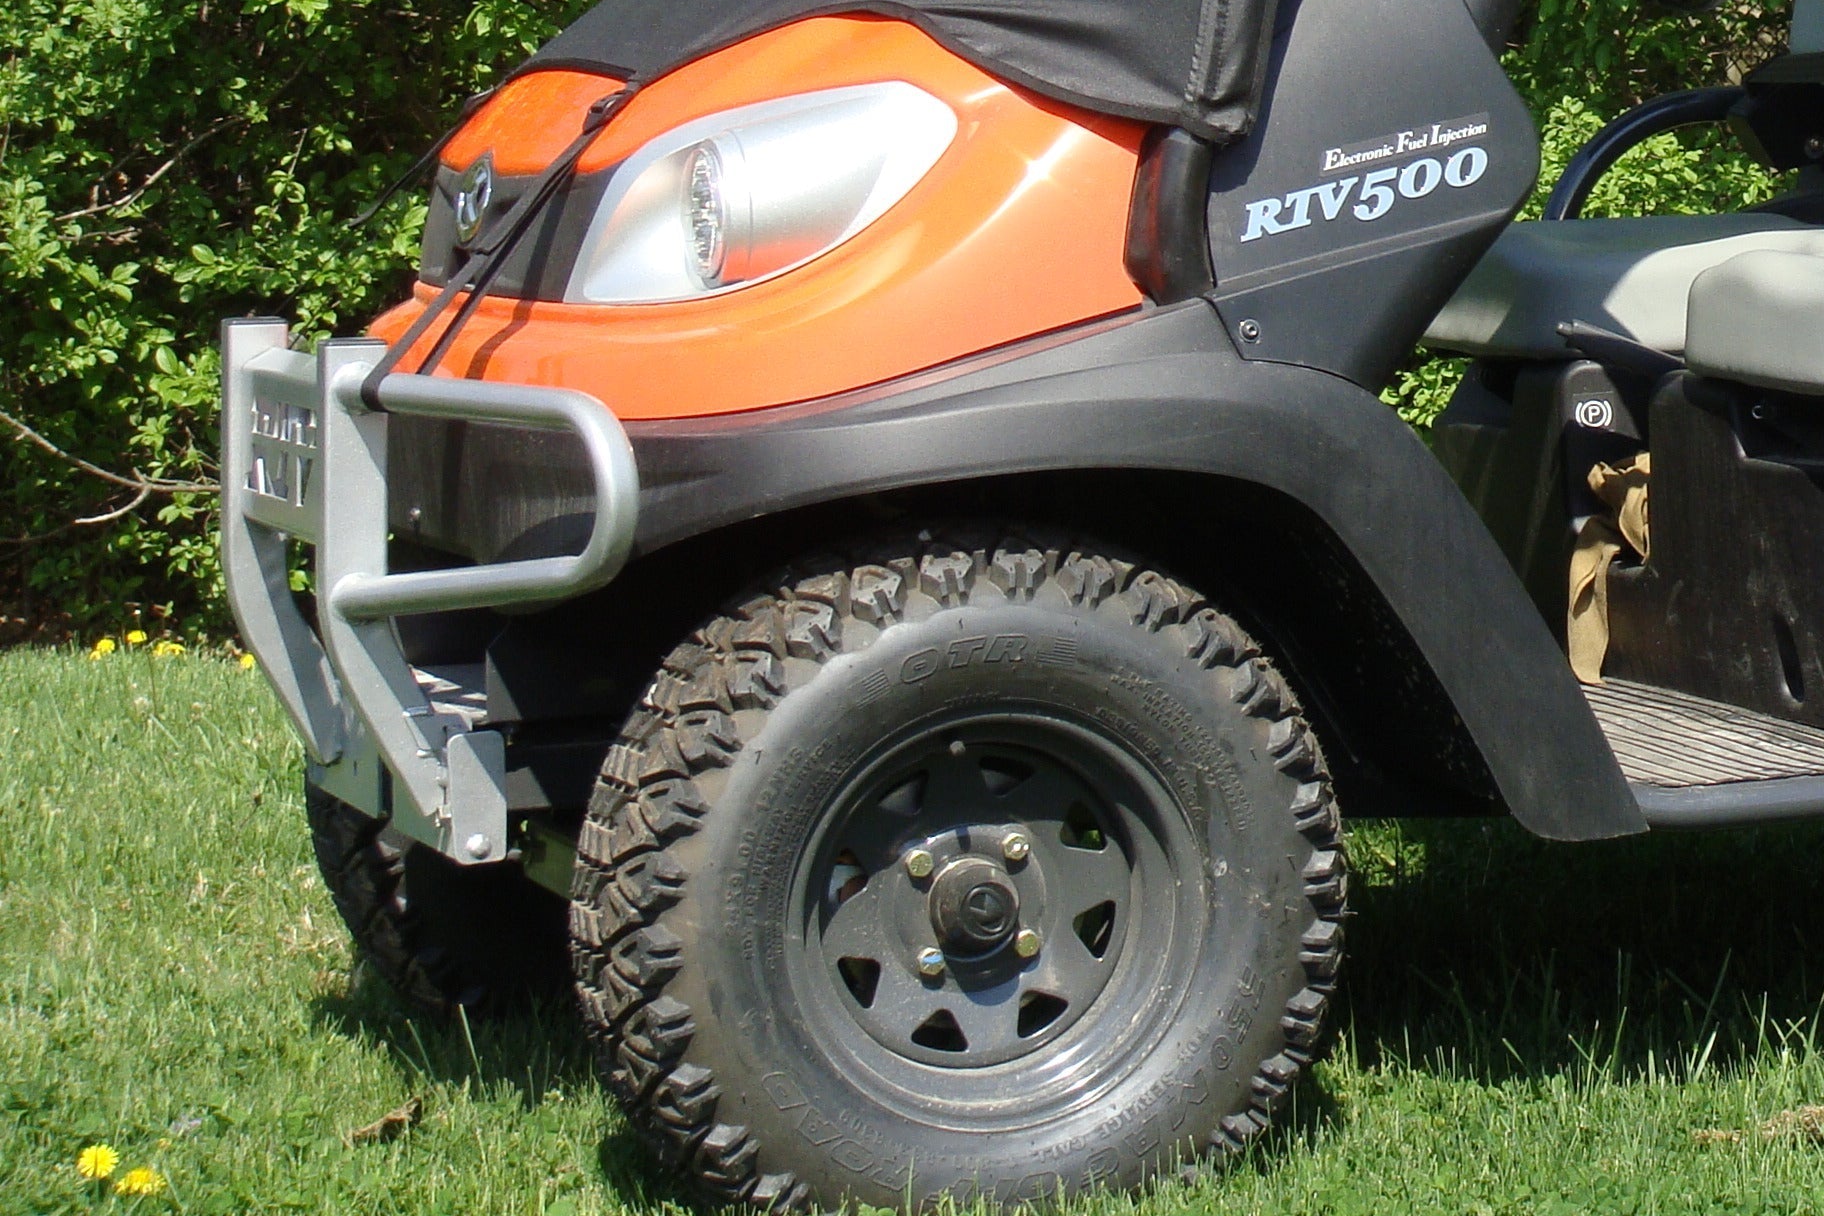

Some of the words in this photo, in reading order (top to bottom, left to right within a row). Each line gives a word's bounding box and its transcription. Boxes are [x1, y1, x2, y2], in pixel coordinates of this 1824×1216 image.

[1323, 148, 1393, 171] Electronic
[1396, 131, 1427, 153] Fuel
[1430, 123, 1486, 146] Injection
[1240, 147, 1489, 243] RTV500
[900, 634, 1029, 683] OTR
[760, 1070, 916, 1196] ROAD
[1100, 1071, 1176, 1138] SERVICE
